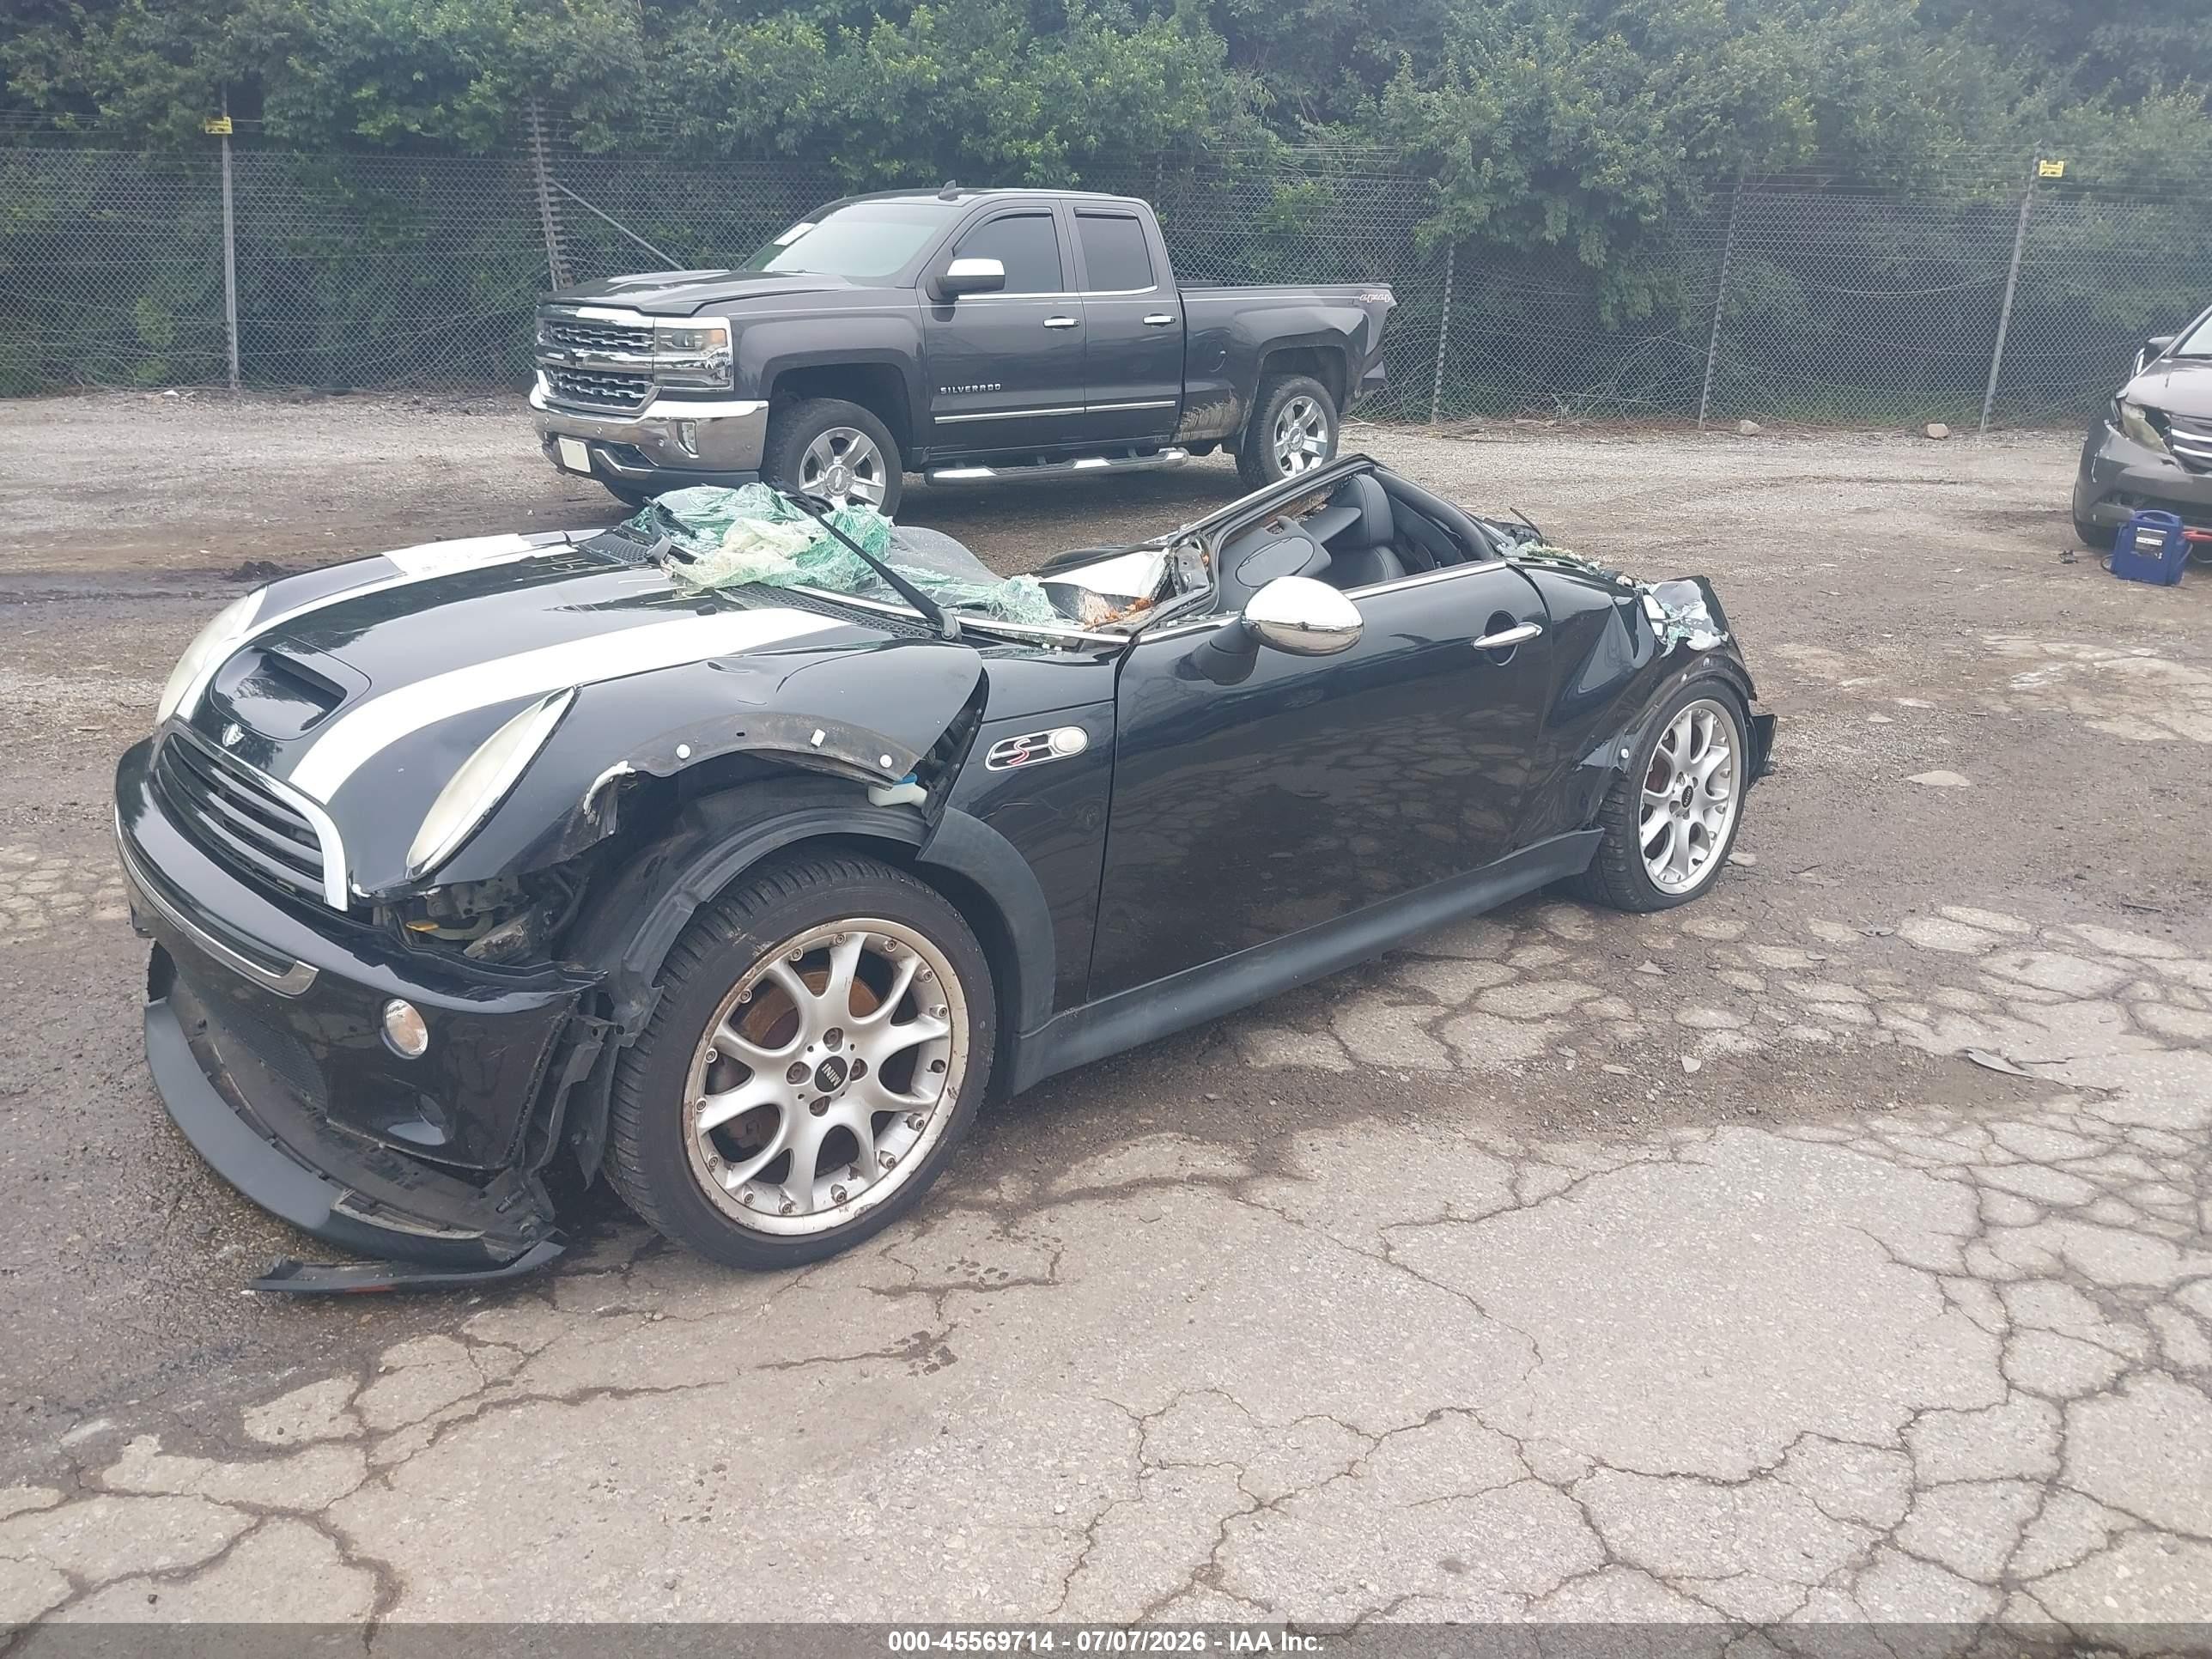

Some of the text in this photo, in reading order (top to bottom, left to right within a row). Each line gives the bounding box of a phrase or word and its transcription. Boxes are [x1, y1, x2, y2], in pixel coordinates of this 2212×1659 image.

[940, 383, 1001, 394] SILVERADO
[1006, 738, 1031, 765] S
[821, 1063, 842, 1086] MINI
